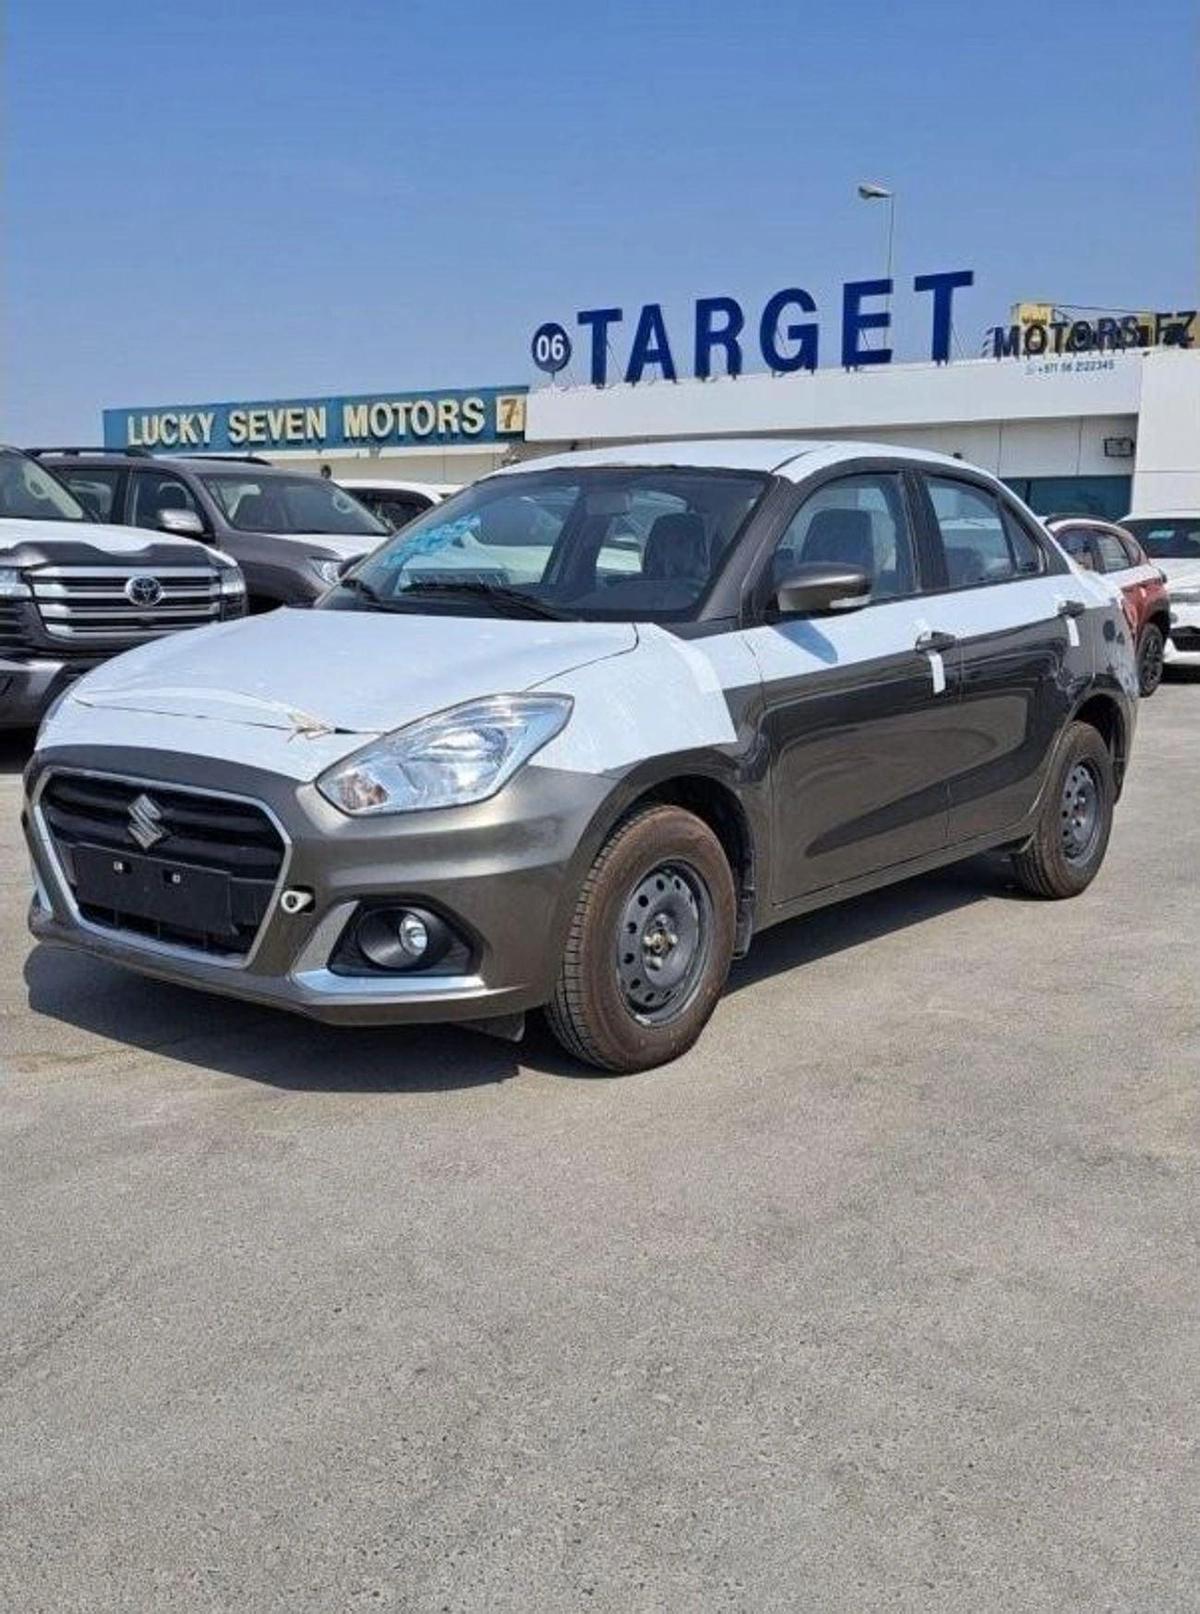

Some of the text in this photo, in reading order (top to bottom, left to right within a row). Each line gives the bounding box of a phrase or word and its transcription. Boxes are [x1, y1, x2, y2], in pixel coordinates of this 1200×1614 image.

[536, 334, 565, 361] 06
[577, 270, 974, 384] TARGET
[993, 314, 1140, 358] MOTORS
[127, 397, 518, 446] LUCKY SEVEN MOTORS 7
